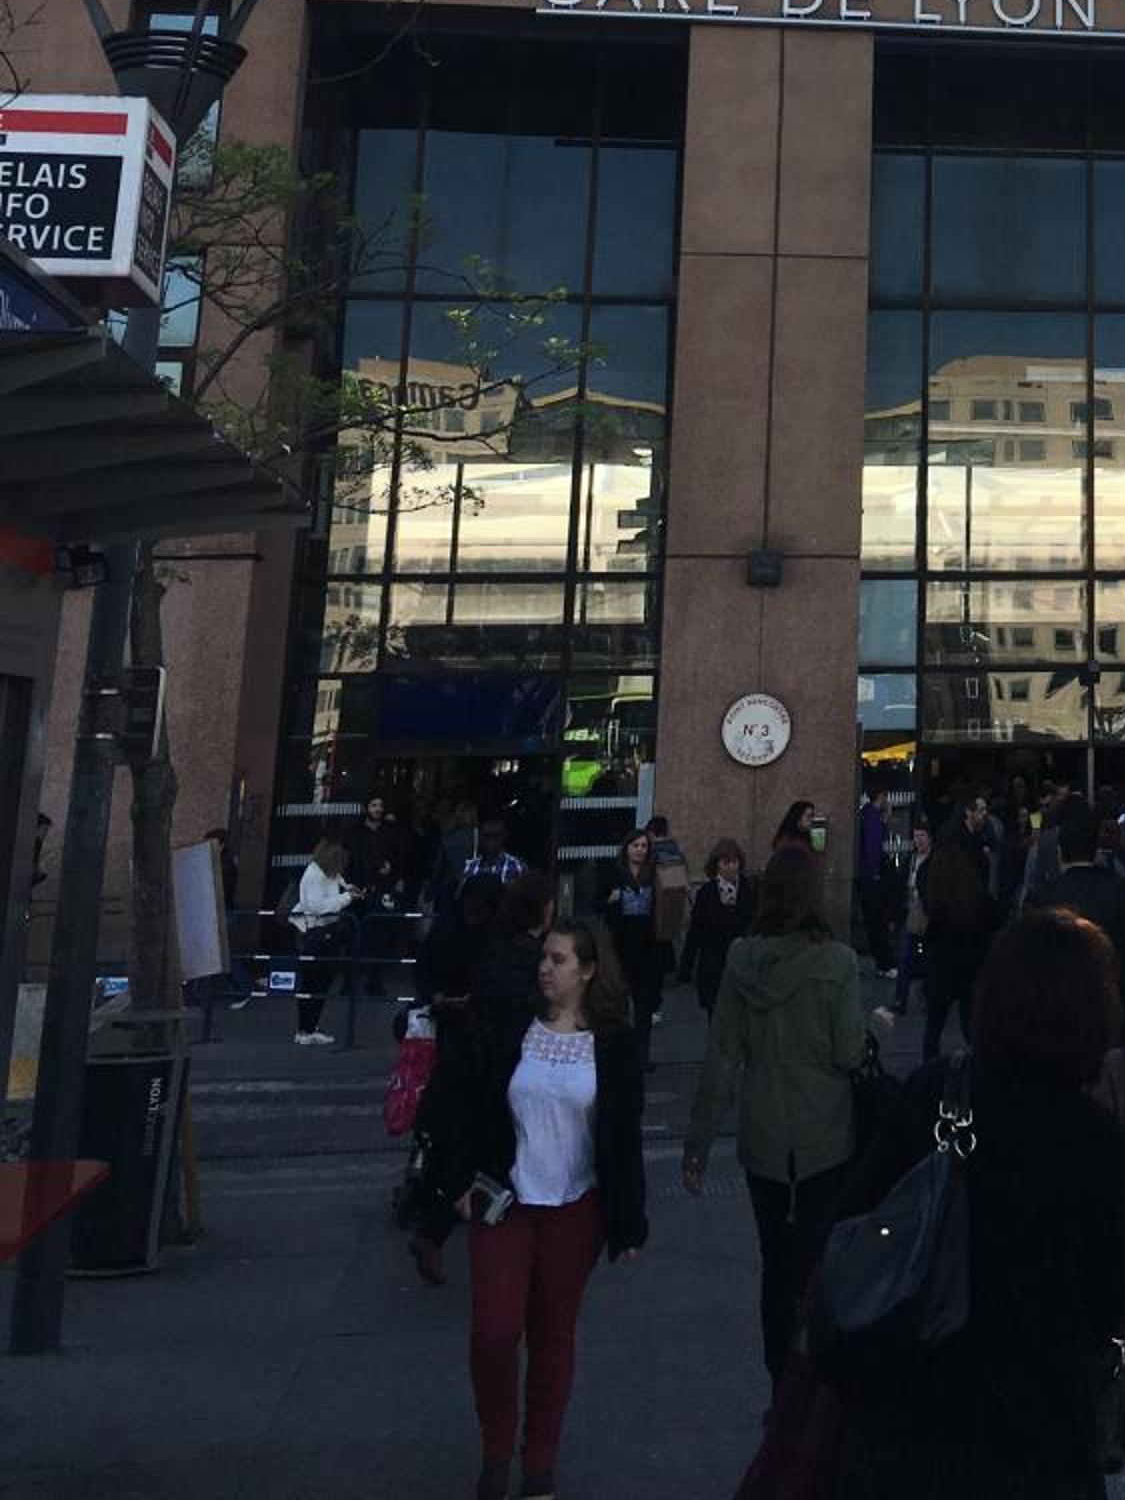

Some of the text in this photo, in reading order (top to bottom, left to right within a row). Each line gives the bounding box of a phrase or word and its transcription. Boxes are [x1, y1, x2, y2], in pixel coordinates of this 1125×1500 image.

[0, 192, 49, 219] FO
[0, 223, 105, 251] RVICE
[761, 724, 769, 737] 3
